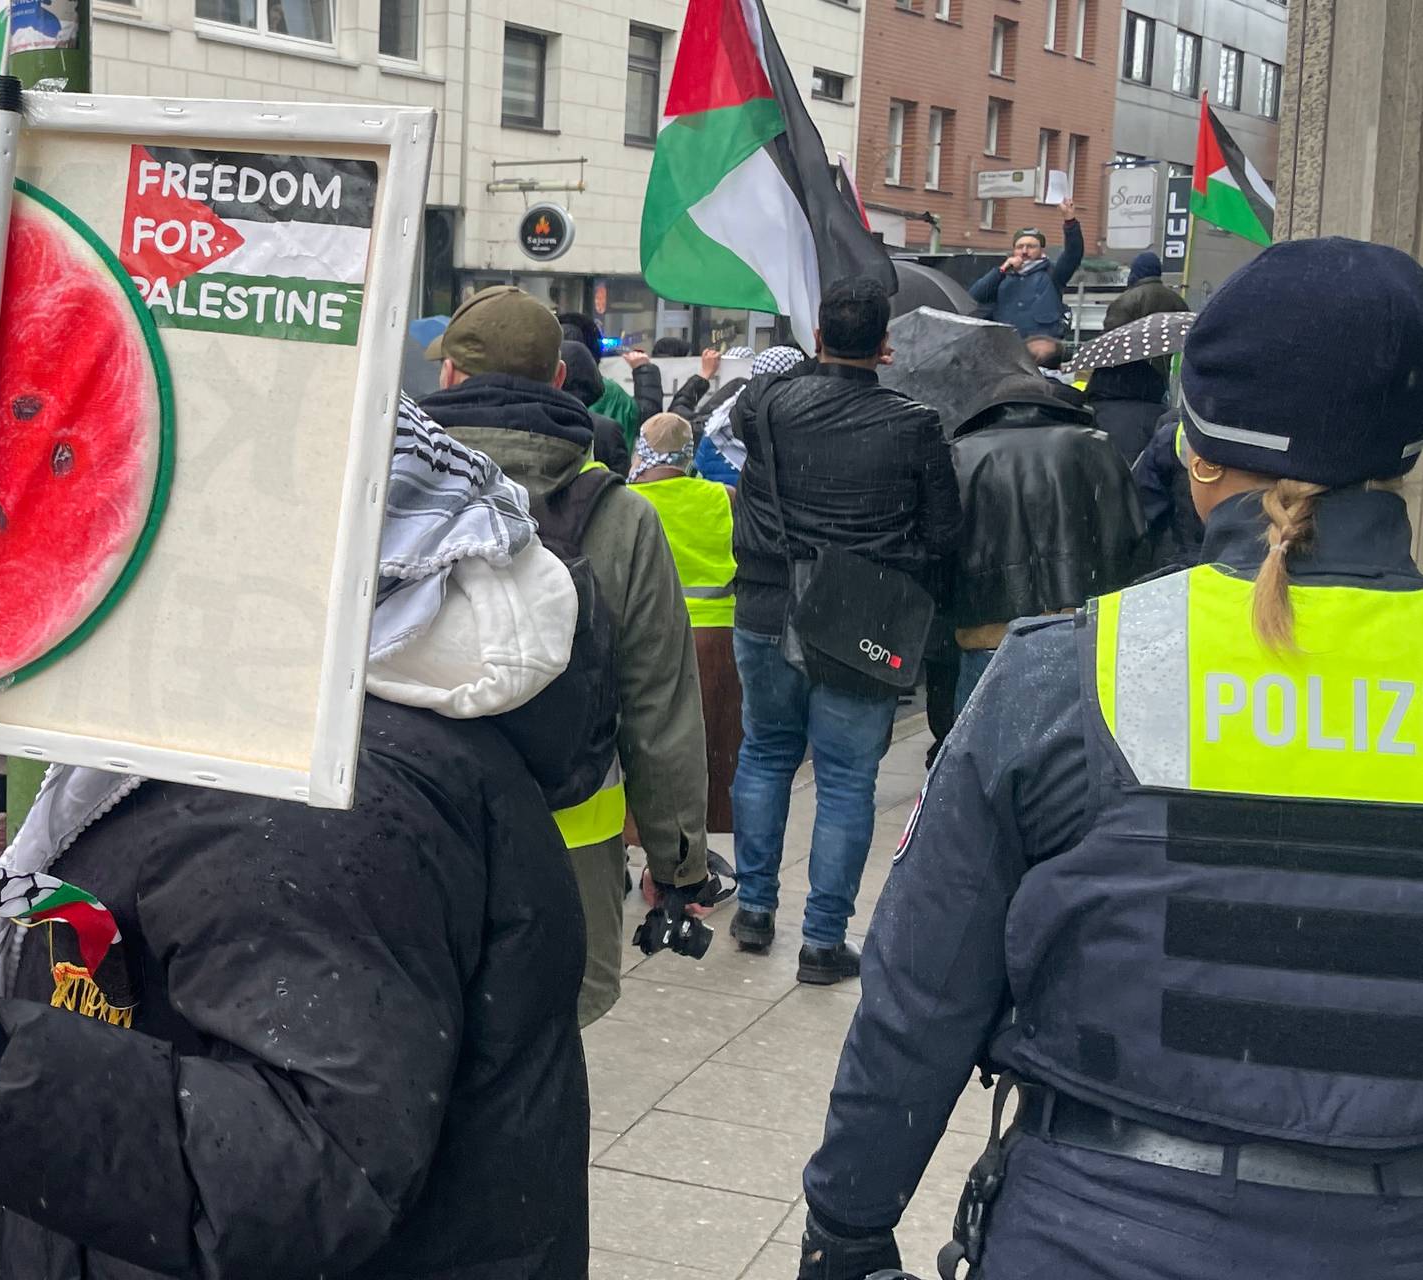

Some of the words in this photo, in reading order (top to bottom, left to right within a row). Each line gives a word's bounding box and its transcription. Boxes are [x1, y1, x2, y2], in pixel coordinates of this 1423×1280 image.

[137, 160, 342, 209] FREEDOM
[132, 216, 216, 257] FOR
[132, 276, 348, 330] PALESTINE
[1205, 672, 1416, 755] POLIZ
